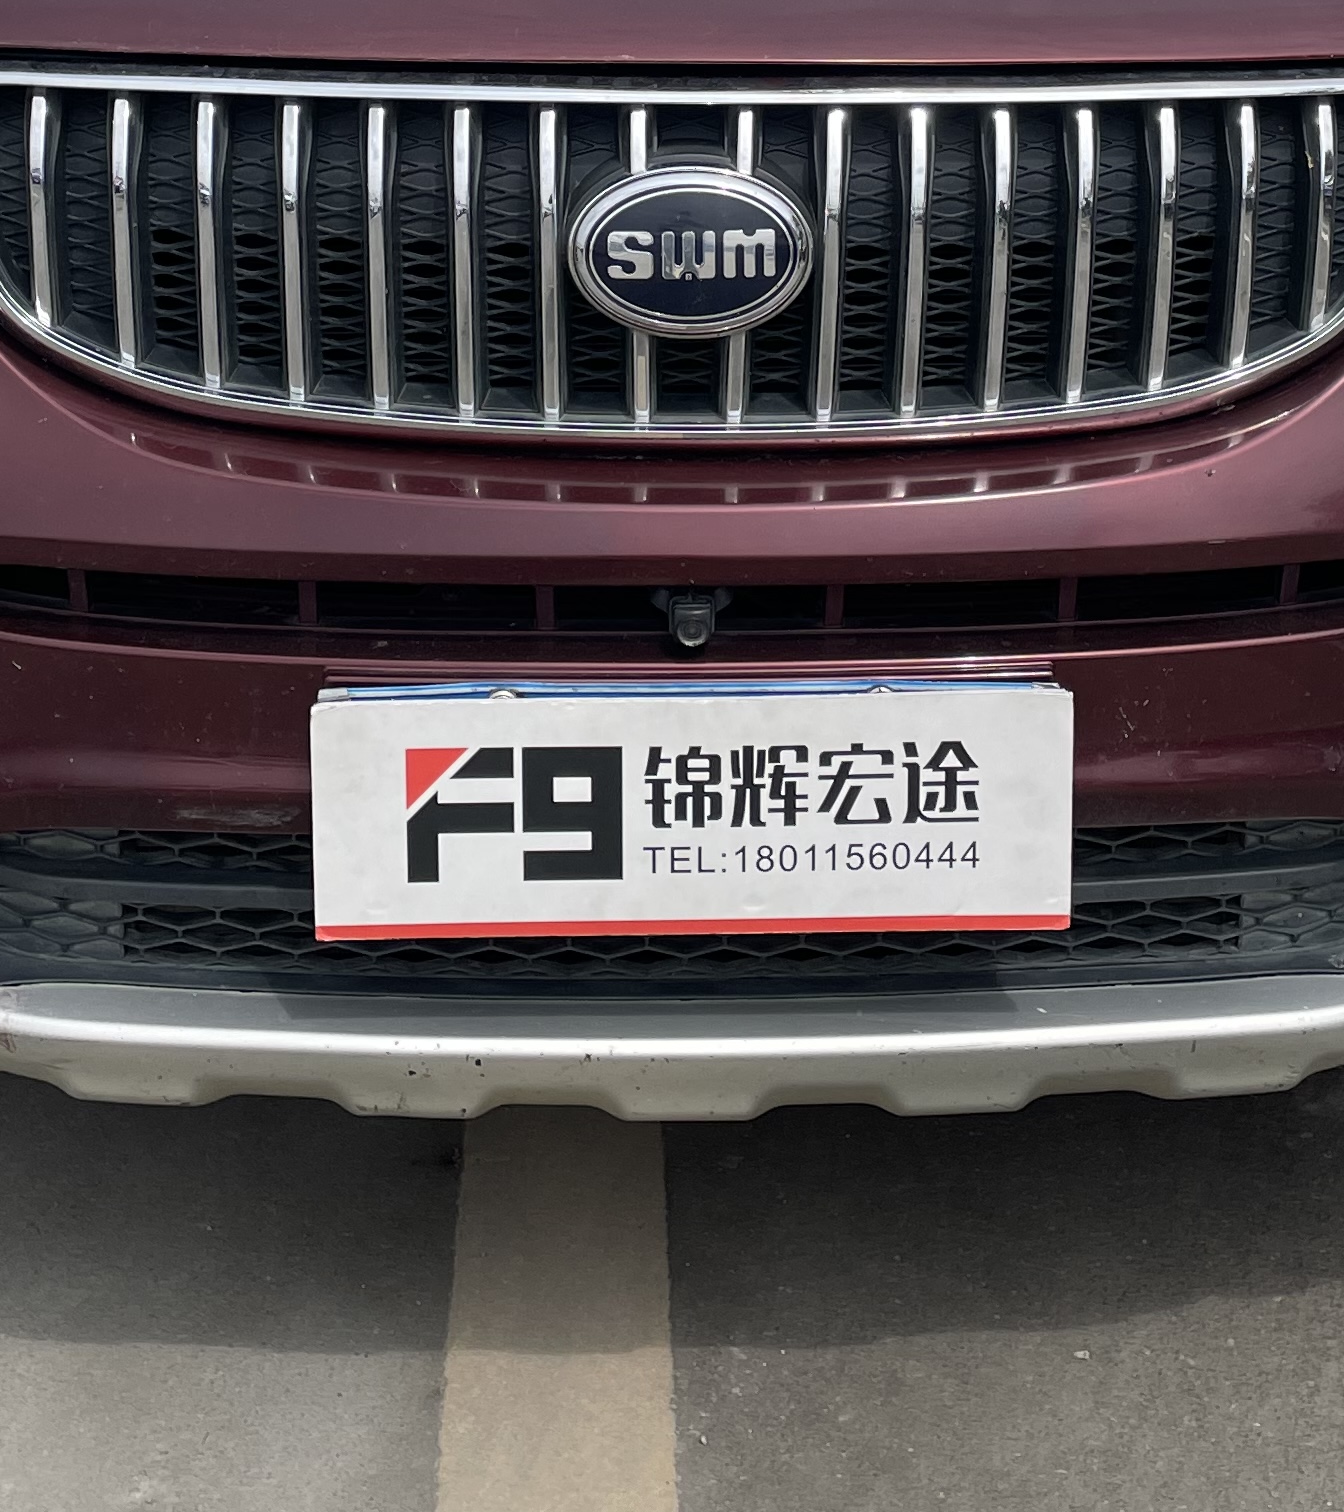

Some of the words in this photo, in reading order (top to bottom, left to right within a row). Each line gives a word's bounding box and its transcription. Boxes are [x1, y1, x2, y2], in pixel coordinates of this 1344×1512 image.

[644, 740, 980, 828] 锦辉宏途
[643, 841, 980, 874] TEL:18011560444
